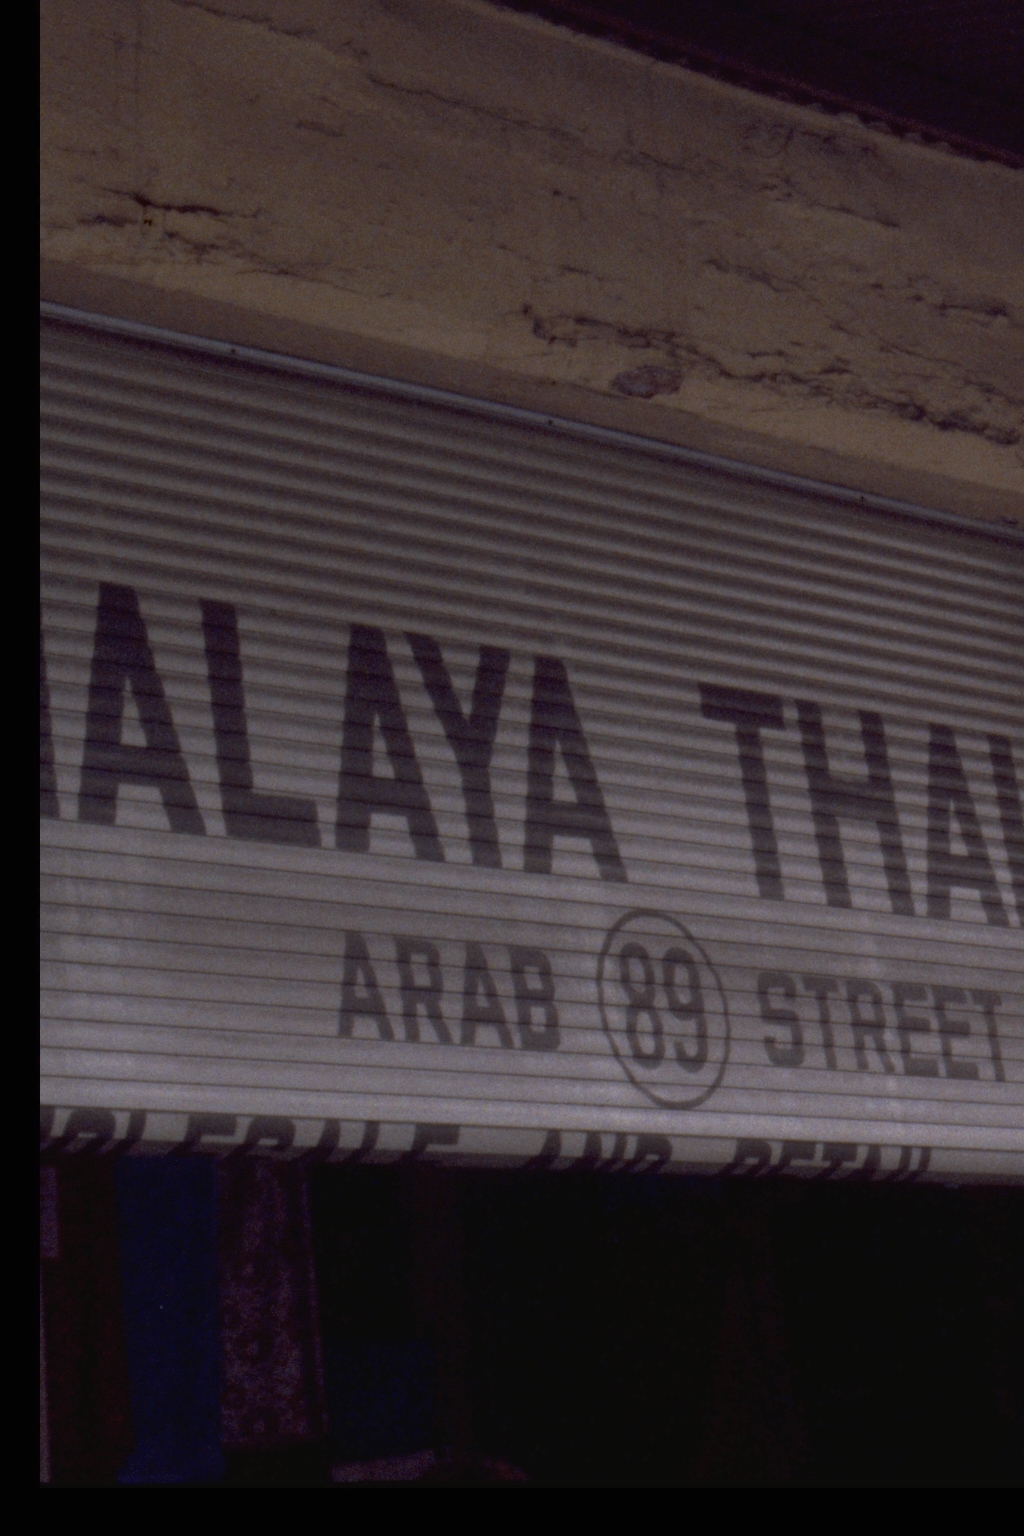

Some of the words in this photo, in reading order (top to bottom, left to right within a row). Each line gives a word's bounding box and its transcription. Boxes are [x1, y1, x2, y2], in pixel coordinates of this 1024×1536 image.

[40, 580, 629, 883] ALAYA
[337, 929, 562, 1052] ARAB
[620, 942, 708, 1073] 89
[758, 971, 1006, 1083] STREET
